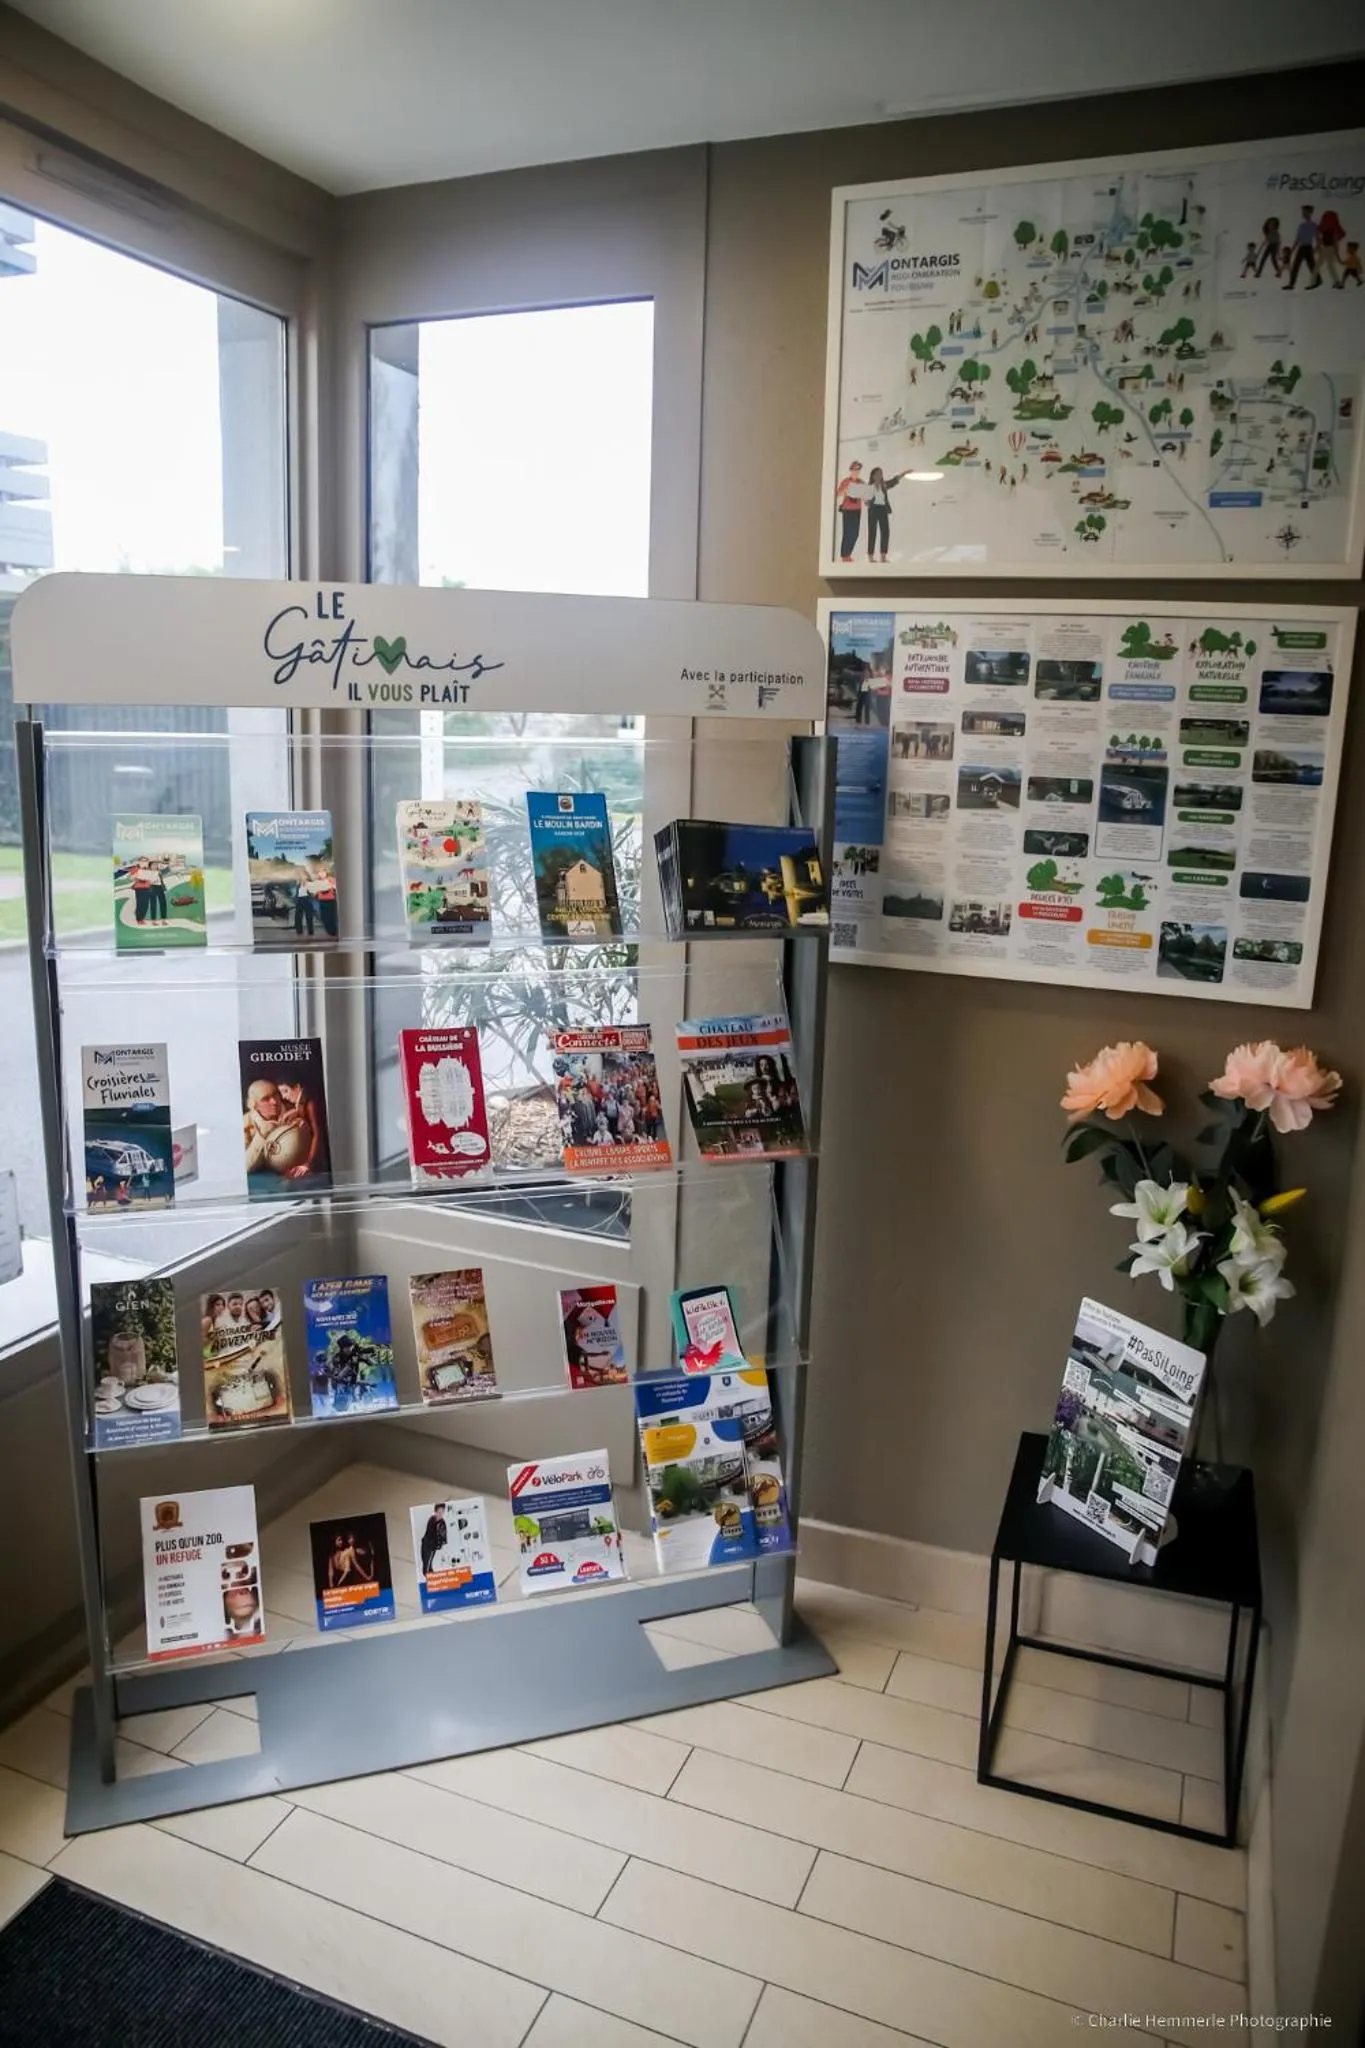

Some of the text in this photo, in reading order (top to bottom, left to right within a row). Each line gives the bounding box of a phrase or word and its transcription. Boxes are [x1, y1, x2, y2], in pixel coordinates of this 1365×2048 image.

[316, 590, 346, 620] LE
[680, 668, 805, 685] Avec la participation
[348, 680, 471, 703] IL VOUS PLAÎT
[250, 1051, 312, 1063] GIRODET
[86, 1071, 147, 1090] Croisières
[100, 1085, 155, 1104] Fluviales
[115, 1299, 150, 1312] GIEN
[1126, 1334, 1196, 1392] #PasSiLoing
[541, 1471, 583, 1485] VéloPark
[155, 1538, 178, 1553] PLUS
[155, 1553, 169, 1566] UN
